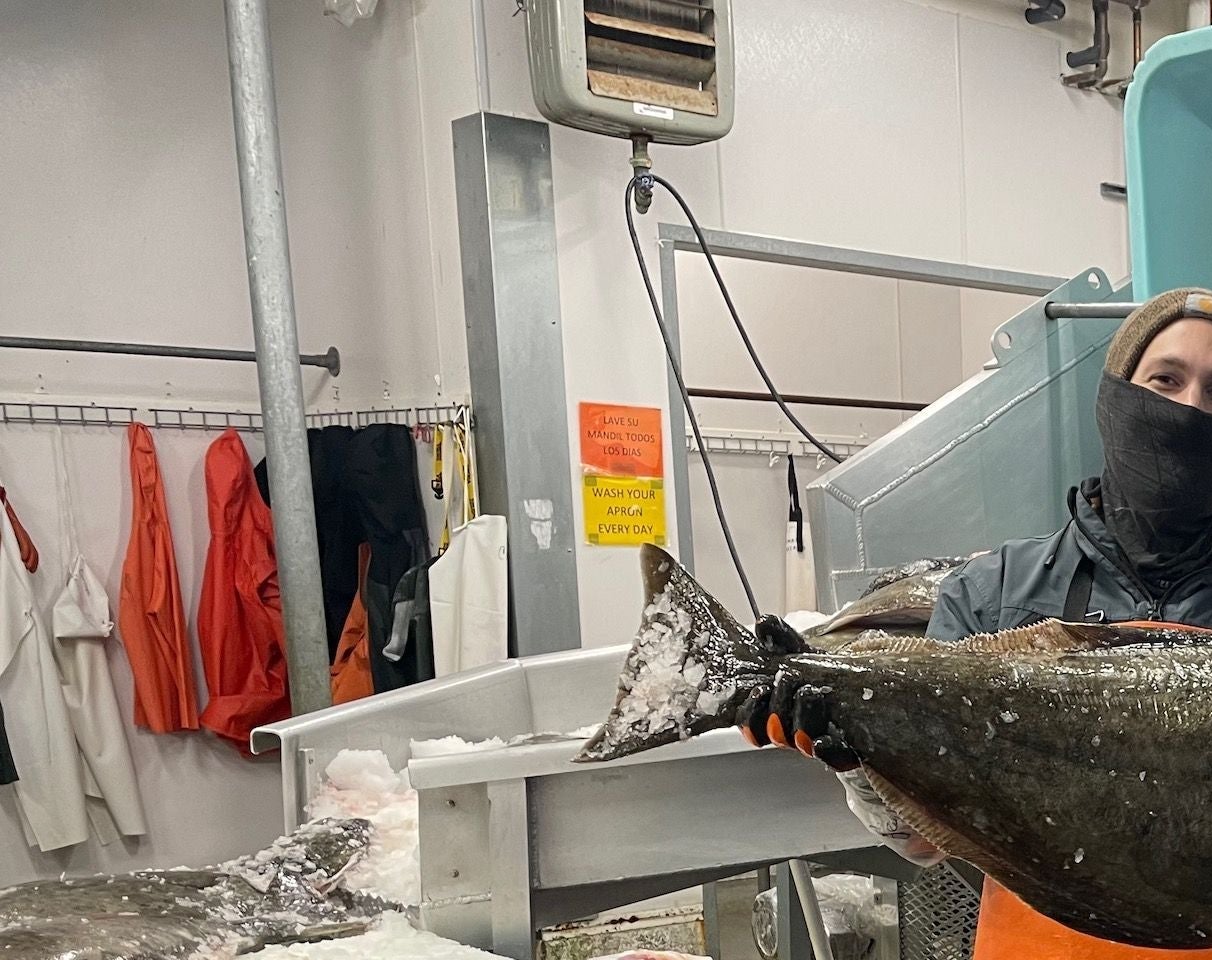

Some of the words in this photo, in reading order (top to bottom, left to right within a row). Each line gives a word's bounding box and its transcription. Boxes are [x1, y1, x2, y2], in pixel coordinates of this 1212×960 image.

[603, 416, 625, 427] LAVE
[627, 416, 639, 427] SU
[587, 429, 623, 441] MANDIL
[626, 433, 655, 443] TODOS
[603, 446, 620, 456] LOS
[621, 448, 642, 457] DIAS
[592, 488, 624, 498] WASH
[627, 489, 656, 499] YOUR
[607, 506, 643, 517] APRON
[598, 524, 630, 534] EVERY
[633, 525, 653, 535] DAY
